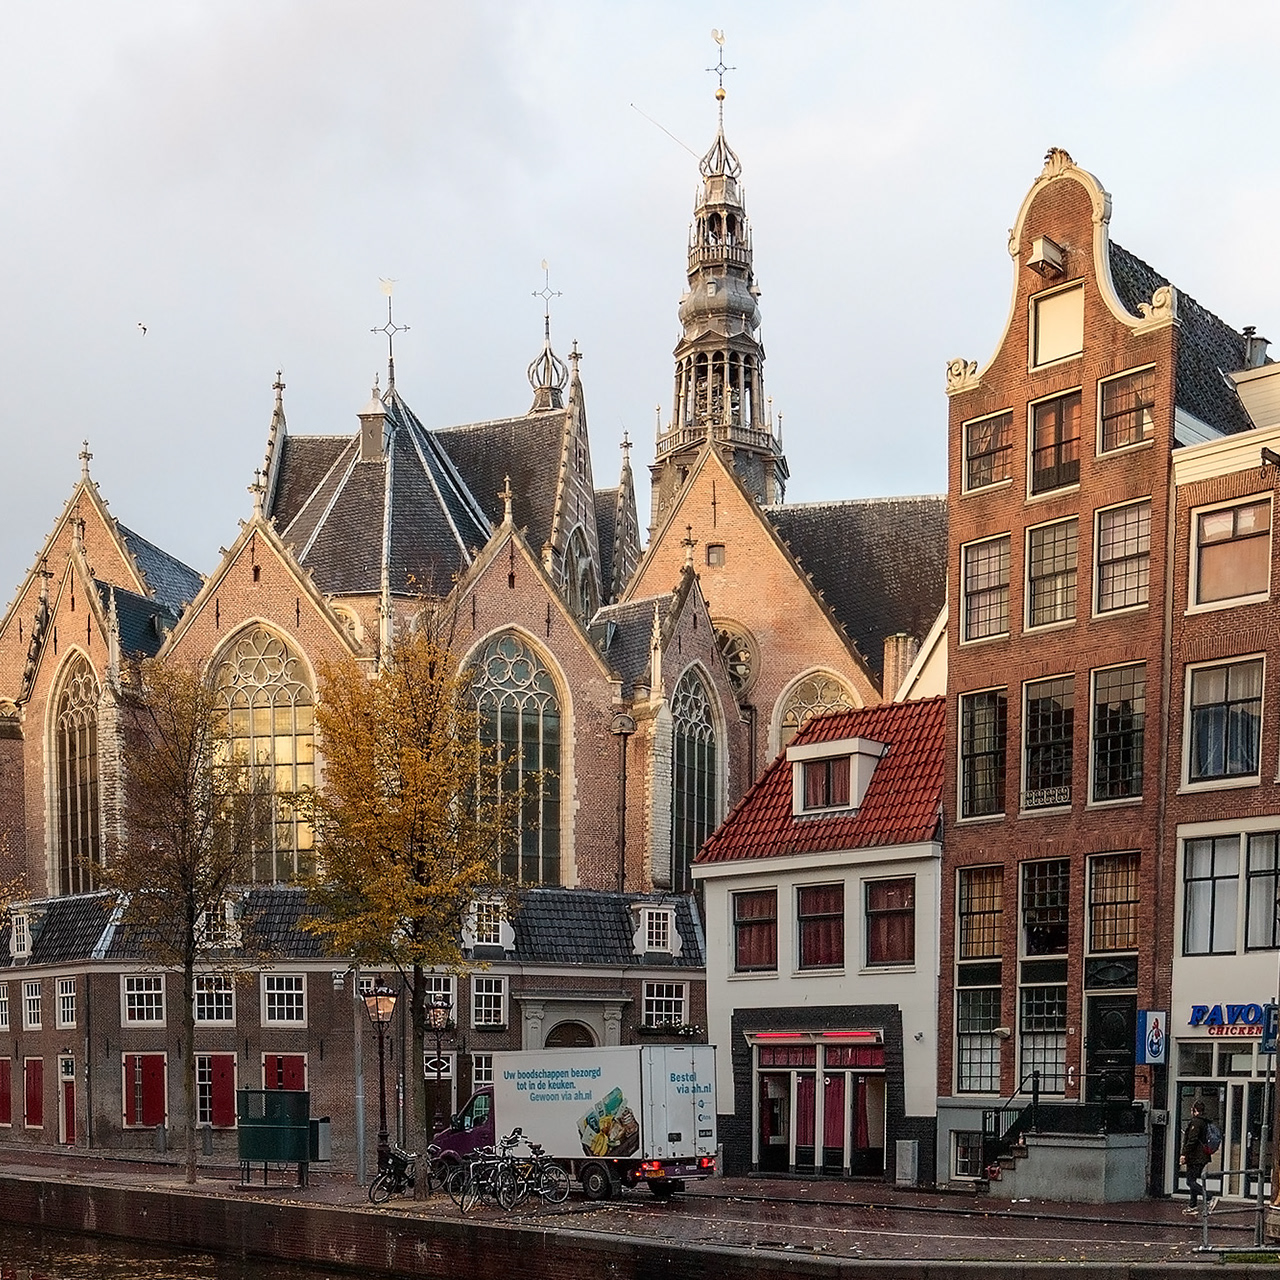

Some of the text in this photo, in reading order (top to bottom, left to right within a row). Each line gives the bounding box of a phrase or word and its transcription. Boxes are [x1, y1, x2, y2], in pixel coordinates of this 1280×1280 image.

[1187, 1003, 1264, 1027] FAVO
[1208, 1026, 1263, 1035] CHICKEN
[503, 1067, 602, 1080] Uw boodschappen bezorgd
[670, 1072, 697, 1082] Bestel
[516, 1080, 576, 1090] tot in de keuken.
[676, 1083, 712, 1094] via ah.nl
[529, 1090, 592, 1102] Gewoon via ah.nl
